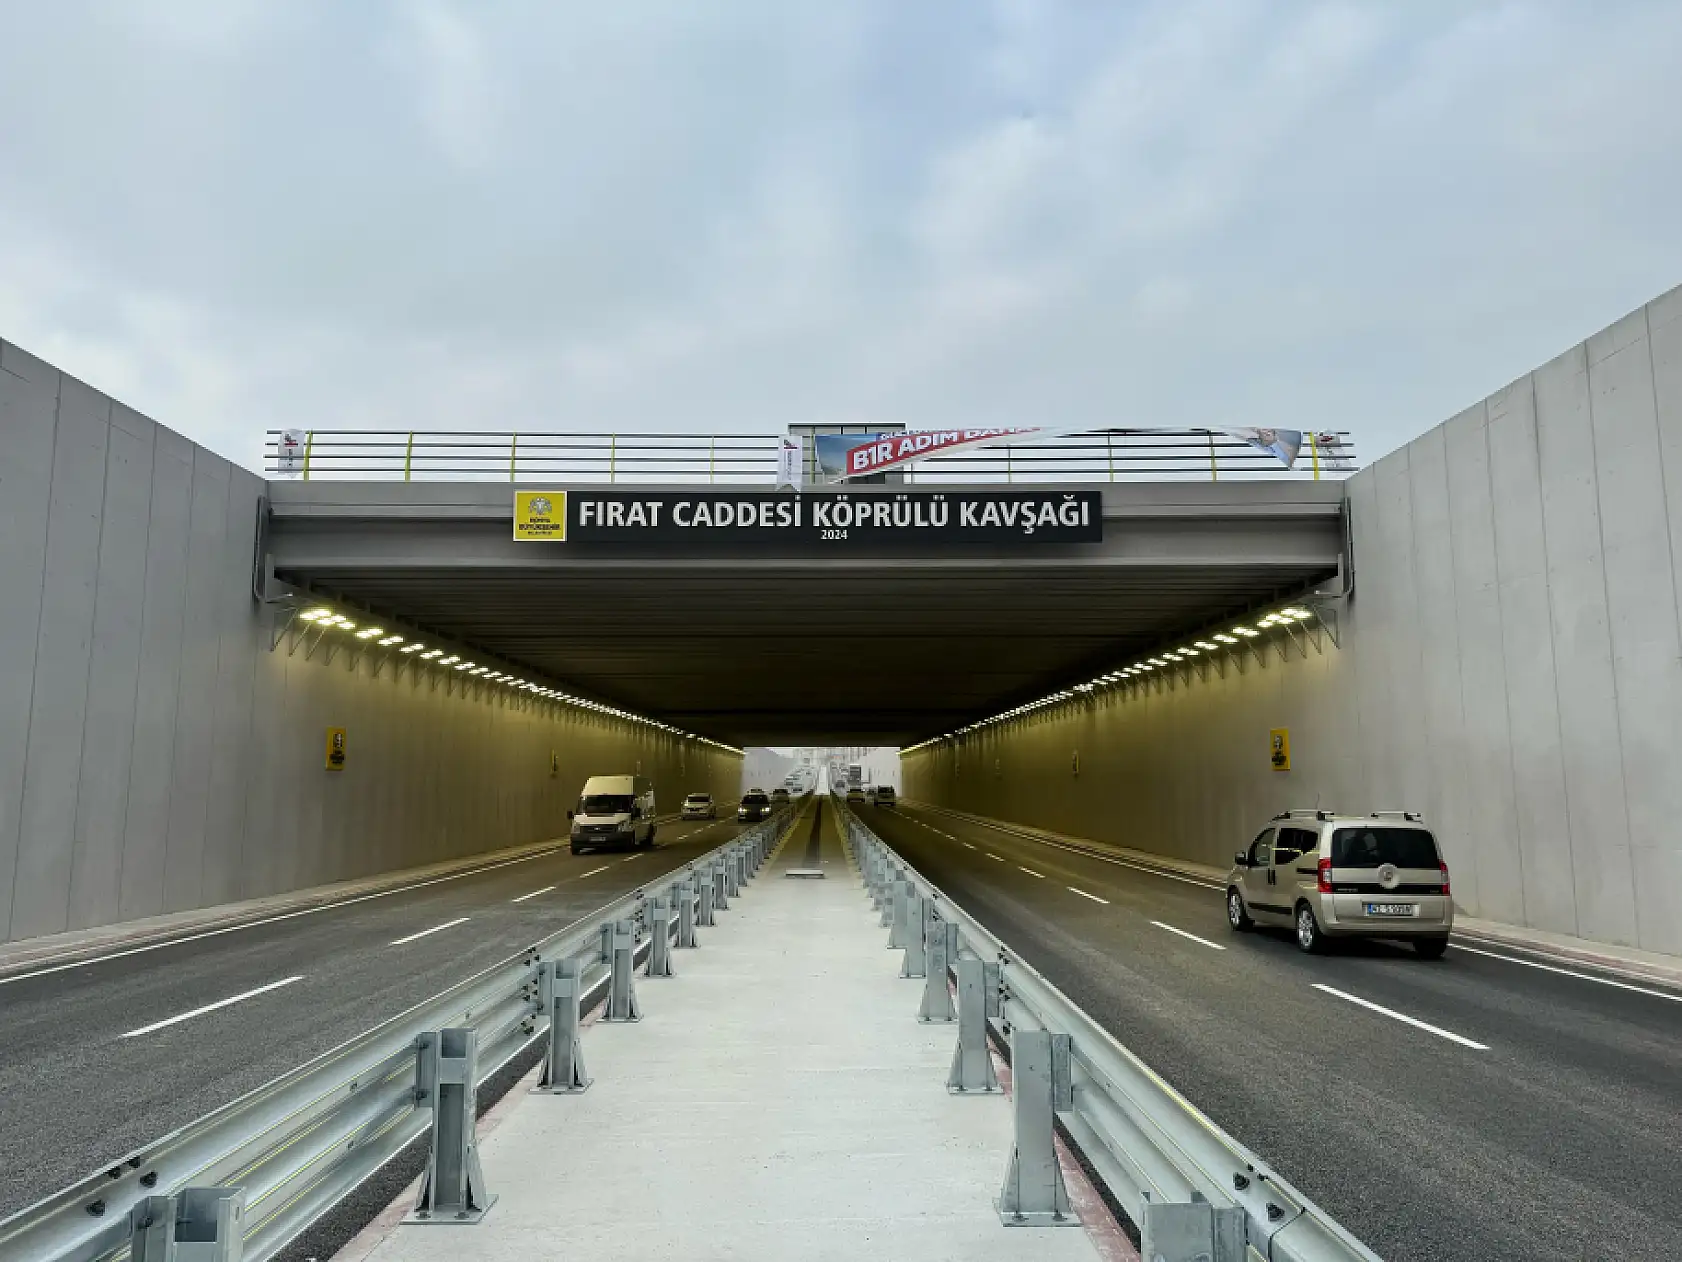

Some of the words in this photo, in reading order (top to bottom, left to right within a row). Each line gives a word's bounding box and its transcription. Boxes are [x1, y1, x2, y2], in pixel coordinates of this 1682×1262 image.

[897, 431, 958, 456] ADIM
[579, 501, 663, 527] FIRAT
[672, 495, 801, 527] CADDESİ
[812, 494, 949, 527] KÖPRÜLÜ
[960, 494, 1090, 534] KAVŞAĞI
[820, 529, 848, 540] 2024
